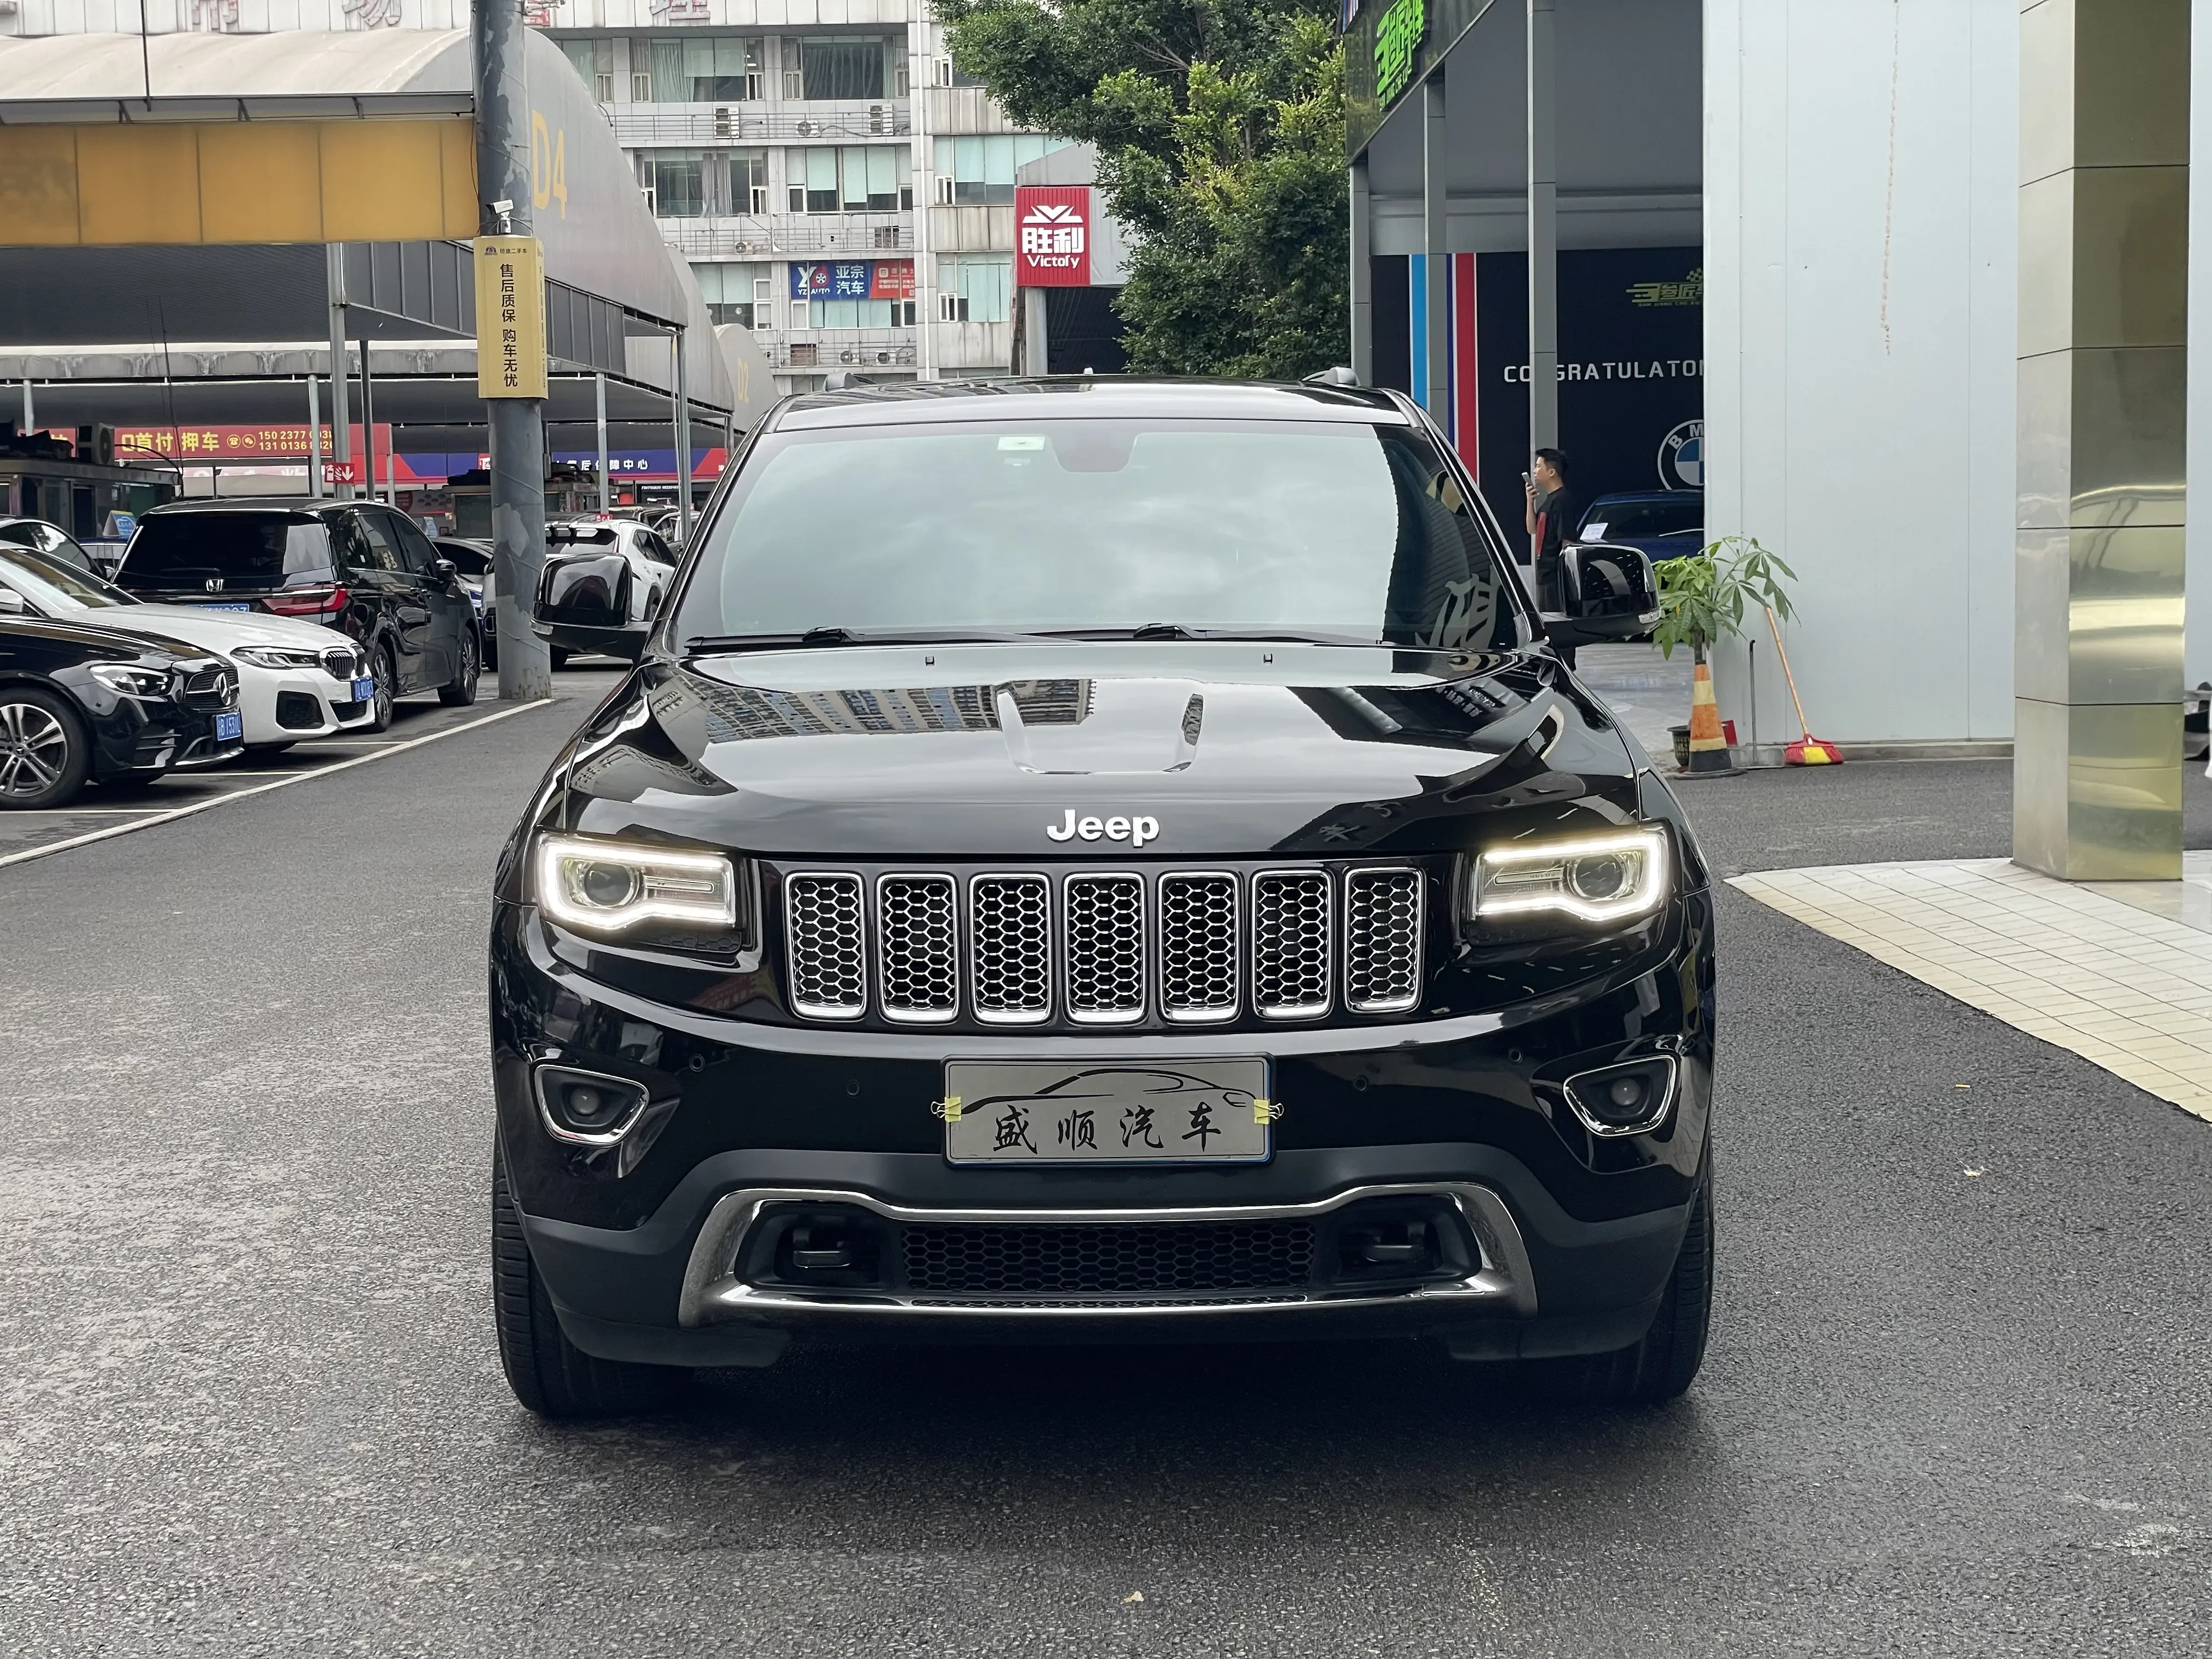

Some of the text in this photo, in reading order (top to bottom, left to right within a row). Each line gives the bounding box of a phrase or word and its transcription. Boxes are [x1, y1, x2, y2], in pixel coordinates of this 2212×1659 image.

[532, 109, 567, 220] D4
[1022, 227, 1084, 253] 胜利
[836, 265, 864, 279] 亚宗
[1026, 255, 1080, 269] Victory
[836, 280, 865, 295] 汽车
[500, 263, 518, 387] 售后质保 购车无忧
[1504, 359, 1704, 382] COGRATULATO
[182, 432, 219, 452] 押车
[258, 431, 278, 440] 150
[280, 431, 306, 439] 2377
[259, 442, 278, 450] 131
[280, 441, 307, 450] 0136
[1668, 424, 1704, 450] BM
[1046, 809, 1160, 848] Jeep
[993, 1102, 1222, 1155] 盛顺汽车
